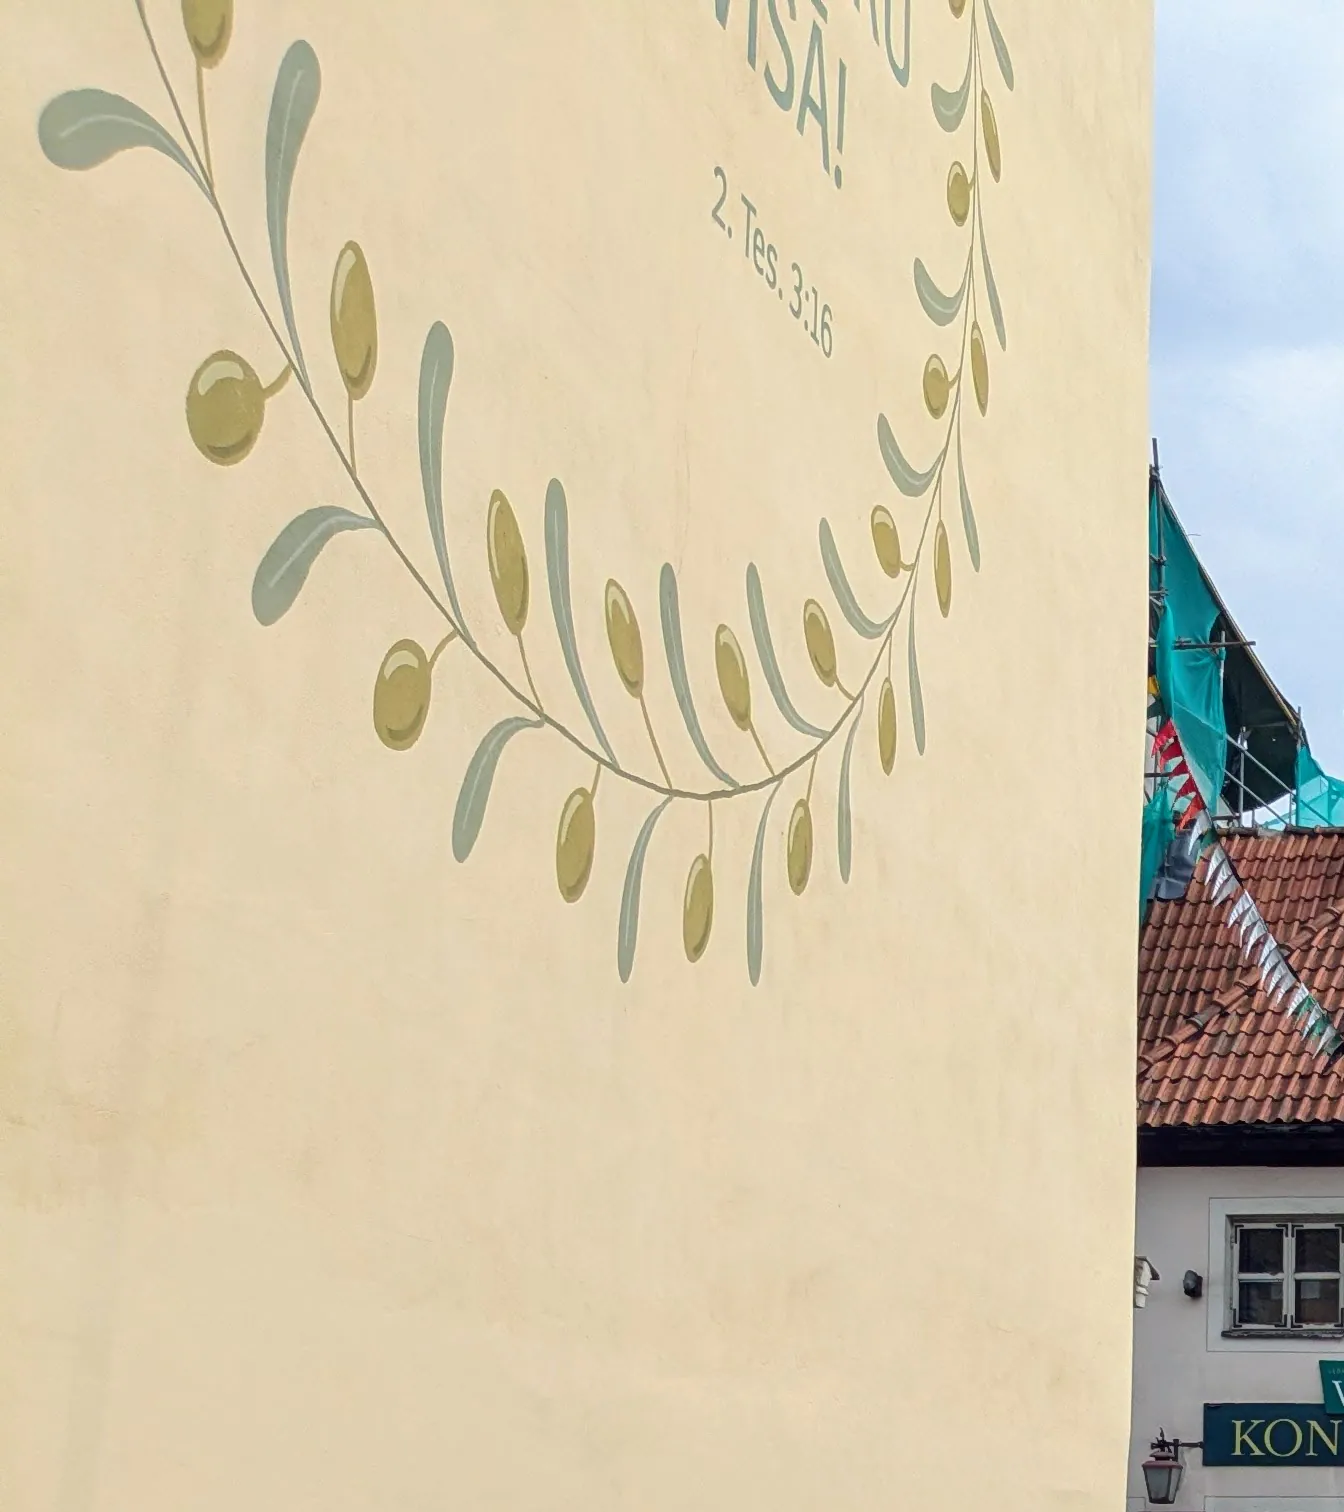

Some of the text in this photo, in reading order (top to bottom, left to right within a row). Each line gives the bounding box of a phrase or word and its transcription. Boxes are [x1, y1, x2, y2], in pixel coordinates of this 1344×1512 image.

[711, 165, 834, 359] 2. Tes. 3:16
